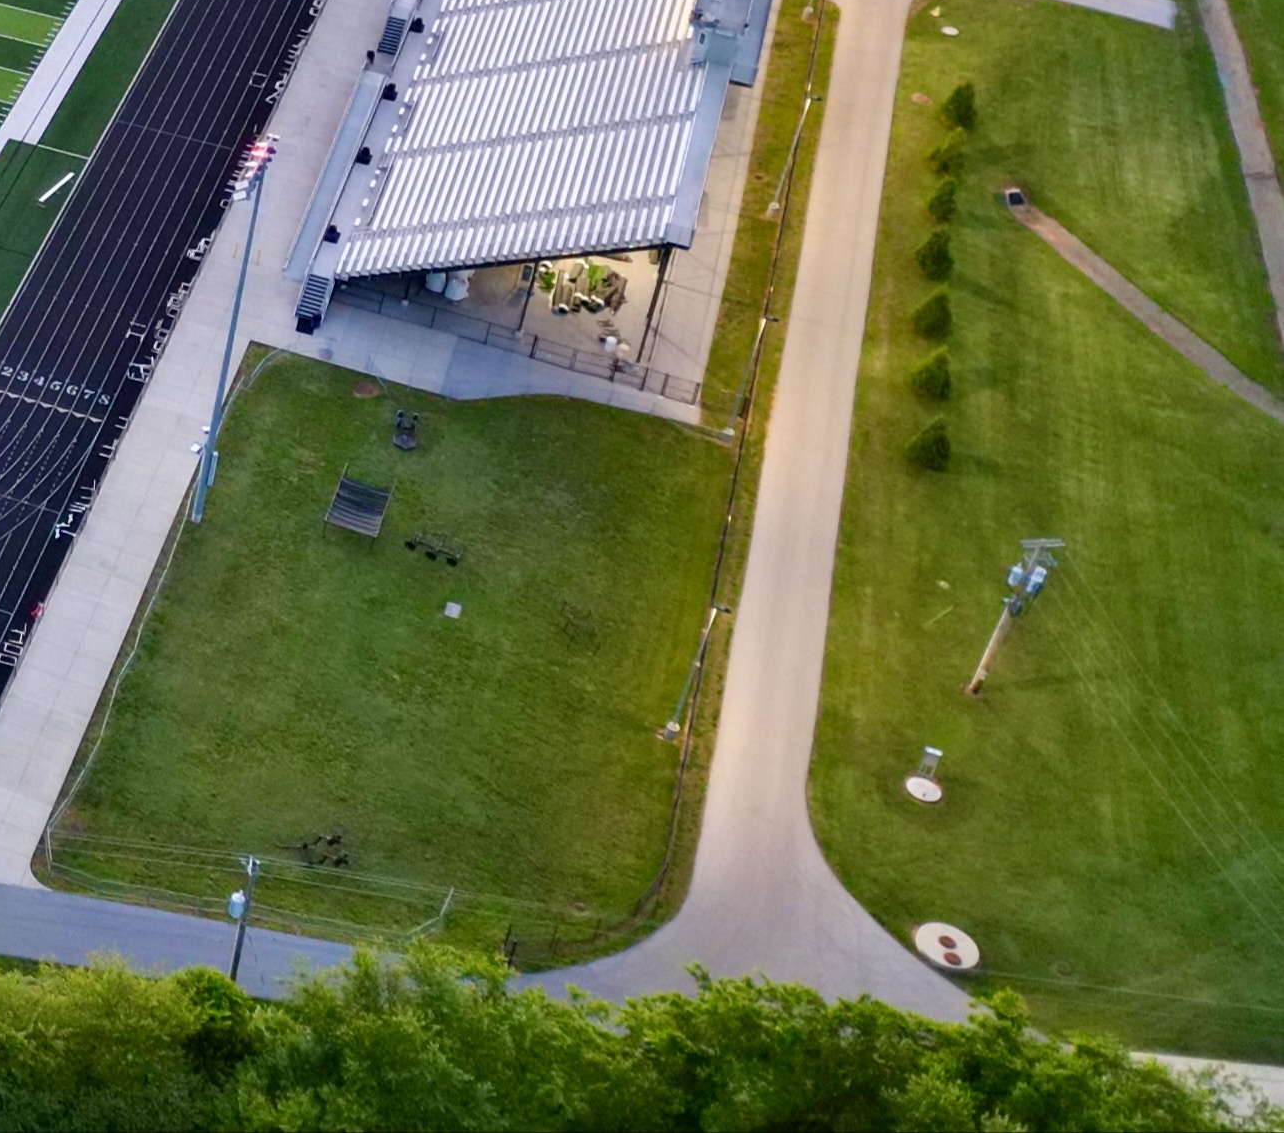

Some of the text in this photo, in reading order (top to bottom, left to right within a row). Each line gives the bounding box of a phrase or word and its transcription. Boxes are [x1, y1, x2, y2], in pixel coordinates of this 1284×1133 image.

[1, 366, 13, 377] 2
[17, 370, 29, 381] 3
[33, 376, 45, 386] 4
[49, 380, 62, 391] 5
[66, 385, 79, 395] 6
[83, 389, 95, 399] 7
[98, 394, 111, 405] 8
